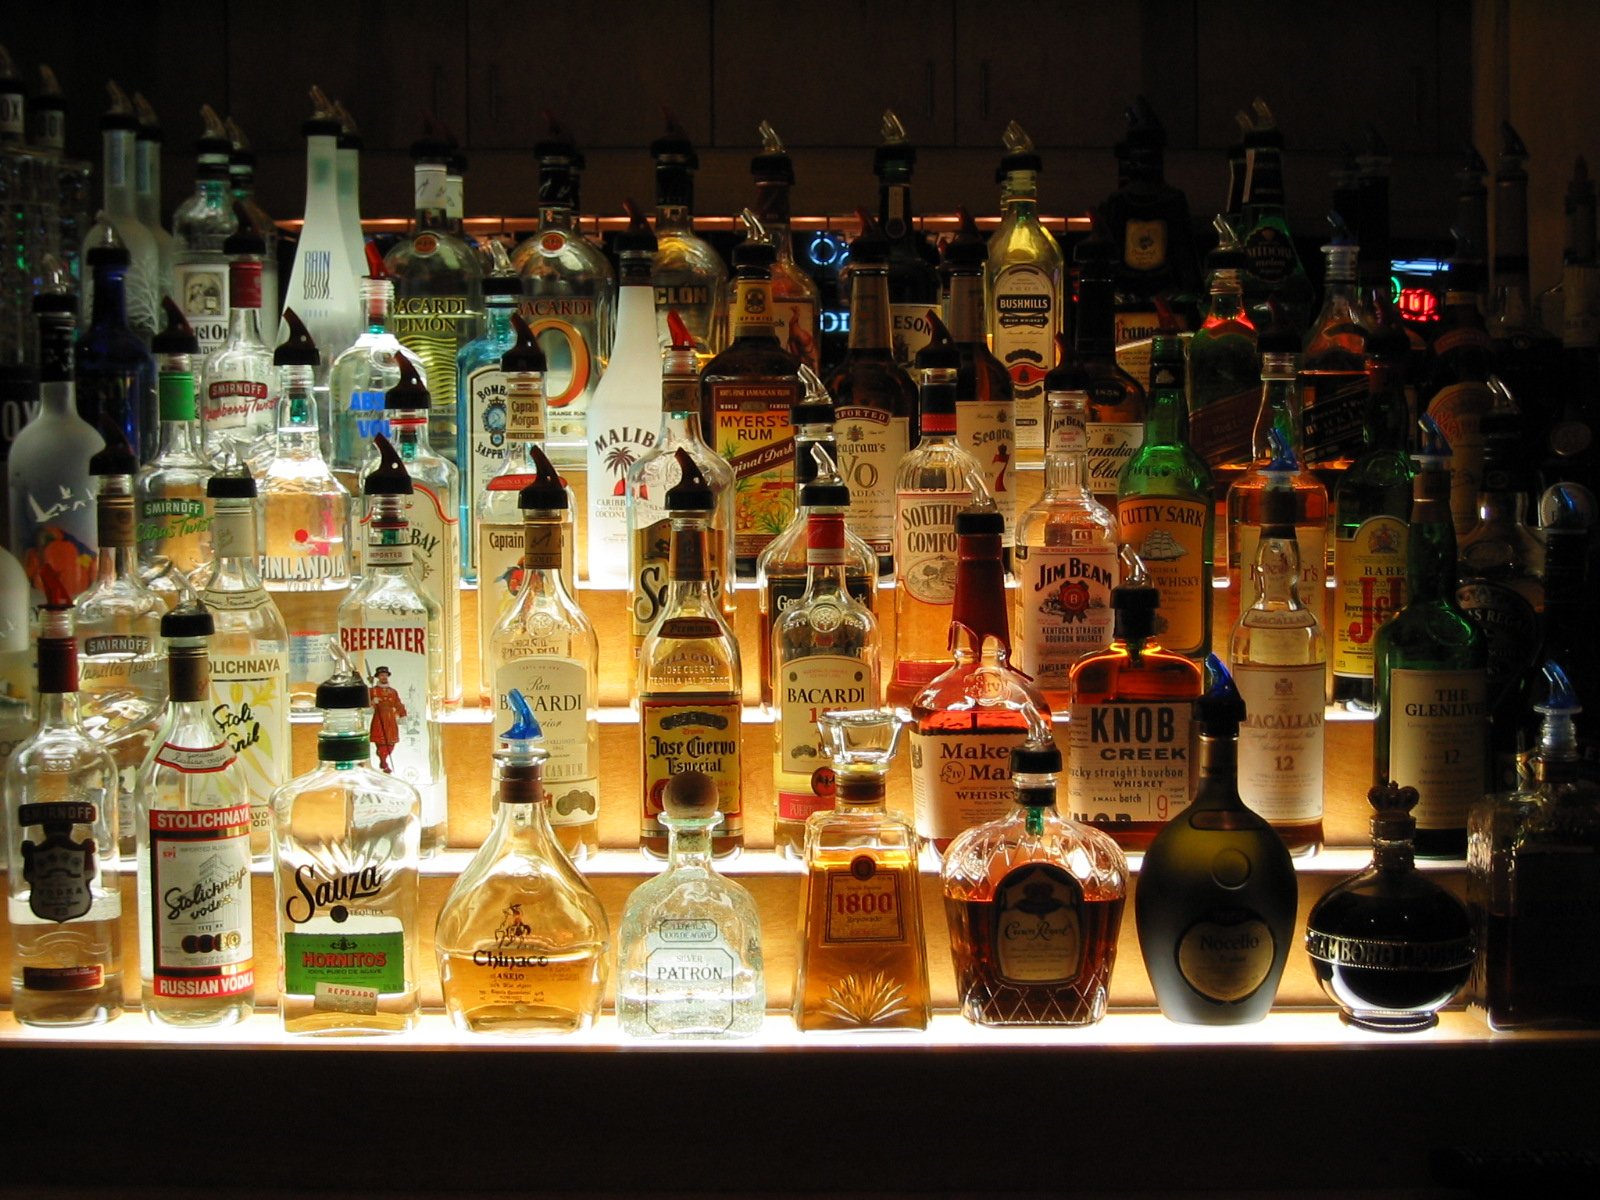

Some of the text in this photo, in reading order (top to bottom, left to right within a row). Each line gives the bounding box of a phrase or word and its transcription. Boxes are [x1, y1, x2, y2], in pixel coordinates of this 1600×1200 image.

[1000, 299, 1048, 309] BUSHMILLS
[212, 382, 263, 396] SMIRNOFF
[511, 400, 539, 414] Captain
[510, 414, 540, 428] Morgan
[720, 415, 790, 428] MYERS'S
[737, 428, 773, 440] RUM
[764, 442, 794, 462] Dark
[991, 452, 1010, 492] 7
[146, 502, 201, 516] SMIRNOFF
[1121, 505, 1205, 528] CUTTY SARK
[489, 532, 524, 550] Captain
[259, 555, 346, 580] FINLANDIA
[1034, 557, 1112, 592] JIM BEAM
[1042, 625, 1105, 635] KENTUCKY STRAIGHT
[89, 639, 148, 652] SMIRNOFF
[340, 627, 426, 656] BEEFEATER
[787, 687, 865, 704] BACARDI
[1436, 689, 1469, 702] THE
[212, 702, 254, 733] Stoli
[1091, 706, 1176, 744] KNOB
[650, 736, 736, 759] Jose Cuervo
[1100, 748, 1187, 761] CREEK
[1274, 756, 1295, 772] 12
[1444, 749, 1460, 764] 12
[1094, 765, 1137, 779] straight
[1141, 766, 1184, 778] bourbon
[1113, 780, 1164, 788] WHISKEY
[1119, 793, 1142, 803] batch
[1157, 794, 1168, 819] 9
[286, 864, 382, 924] Sauza
[836, 893, 893, 916] 1800
[302, 952, 387, 968] HORNITOS
[473, 950, 549, 970] Chinaco
[159, 979, 219, 995] RUSSIAN
[327, 986, 375, 999] REPOSADO
